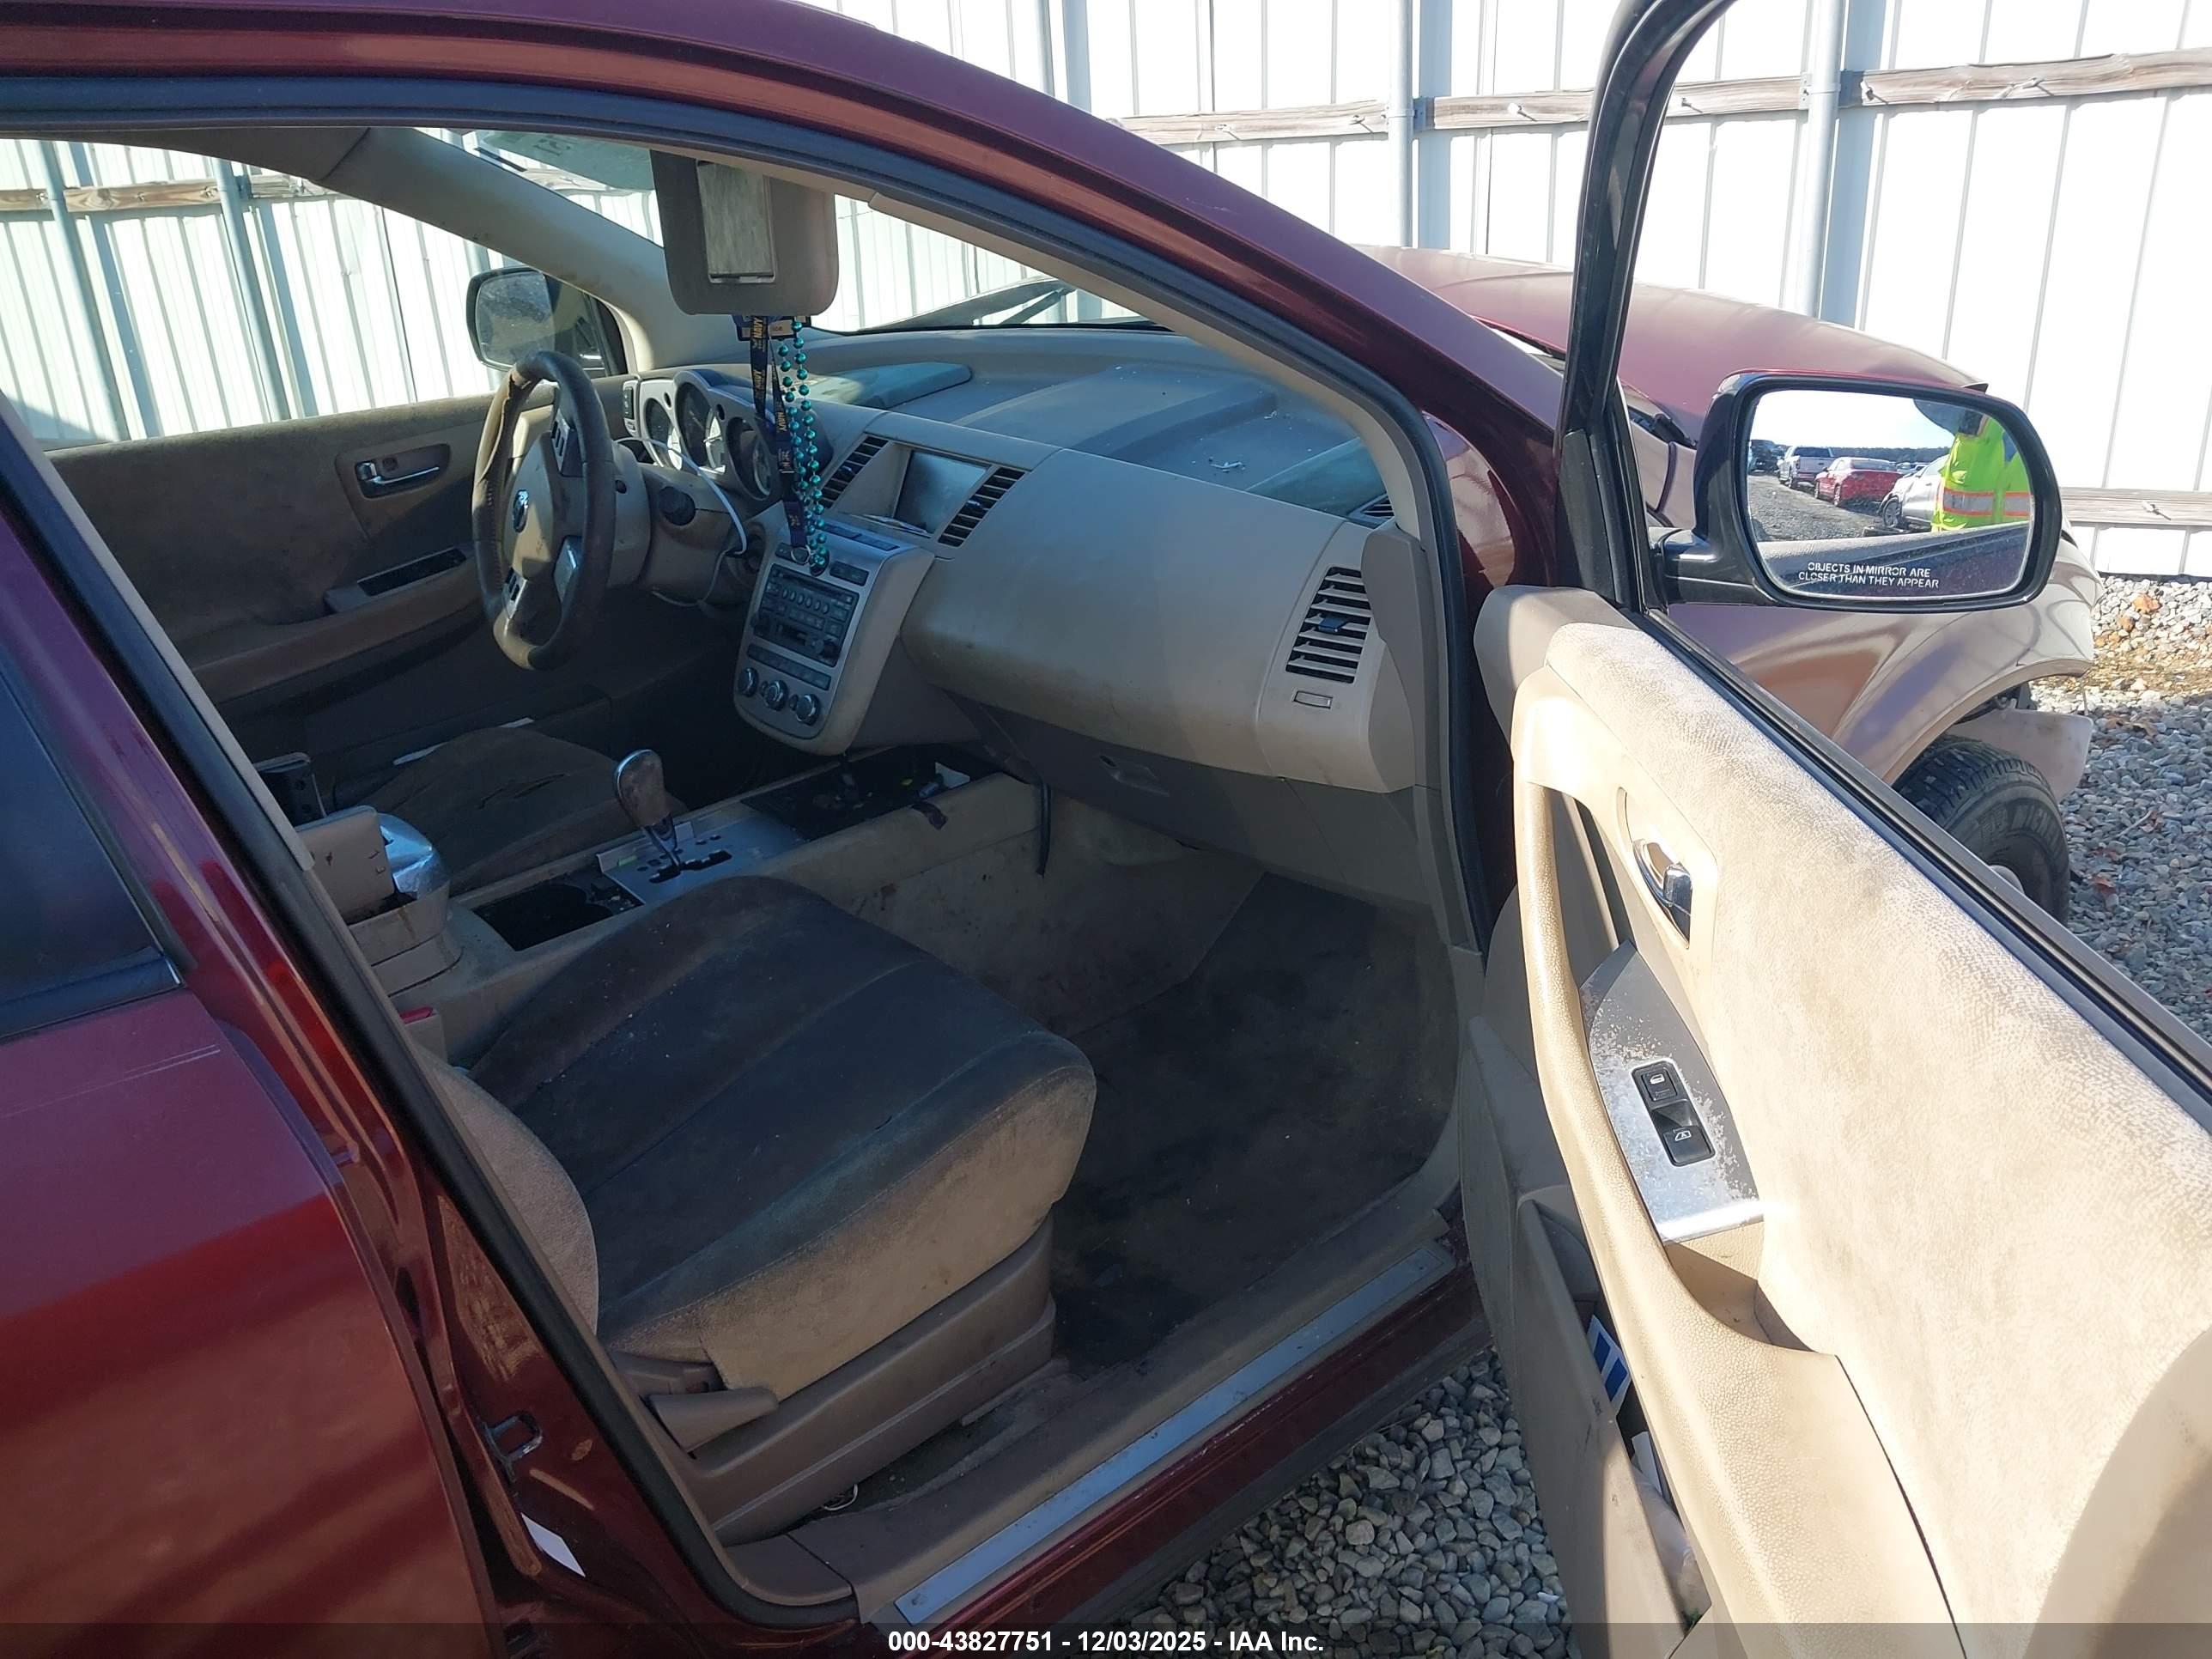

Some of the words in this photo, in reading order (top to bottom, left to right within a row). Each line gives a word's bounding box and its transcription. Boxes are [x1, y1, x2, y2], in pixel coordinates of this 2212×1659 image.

[753, 317, 763, 338] NAVY
[775, 411, 787, 432] NAVY
[1808, 562, 1850, 573] OBJECTS
[1853, 564, 1863, 574] IN
[1865, 565, 1905, 576] MIRROR
[1909, 568, 1930, 578] ARE
[1798, 571, 1836, 582] CLOSER
[1839, 574, 1866, 585] THAN
[1868, 575, 1894, 586] THEY
[1897, 577, 1939, 589] APPEAR
